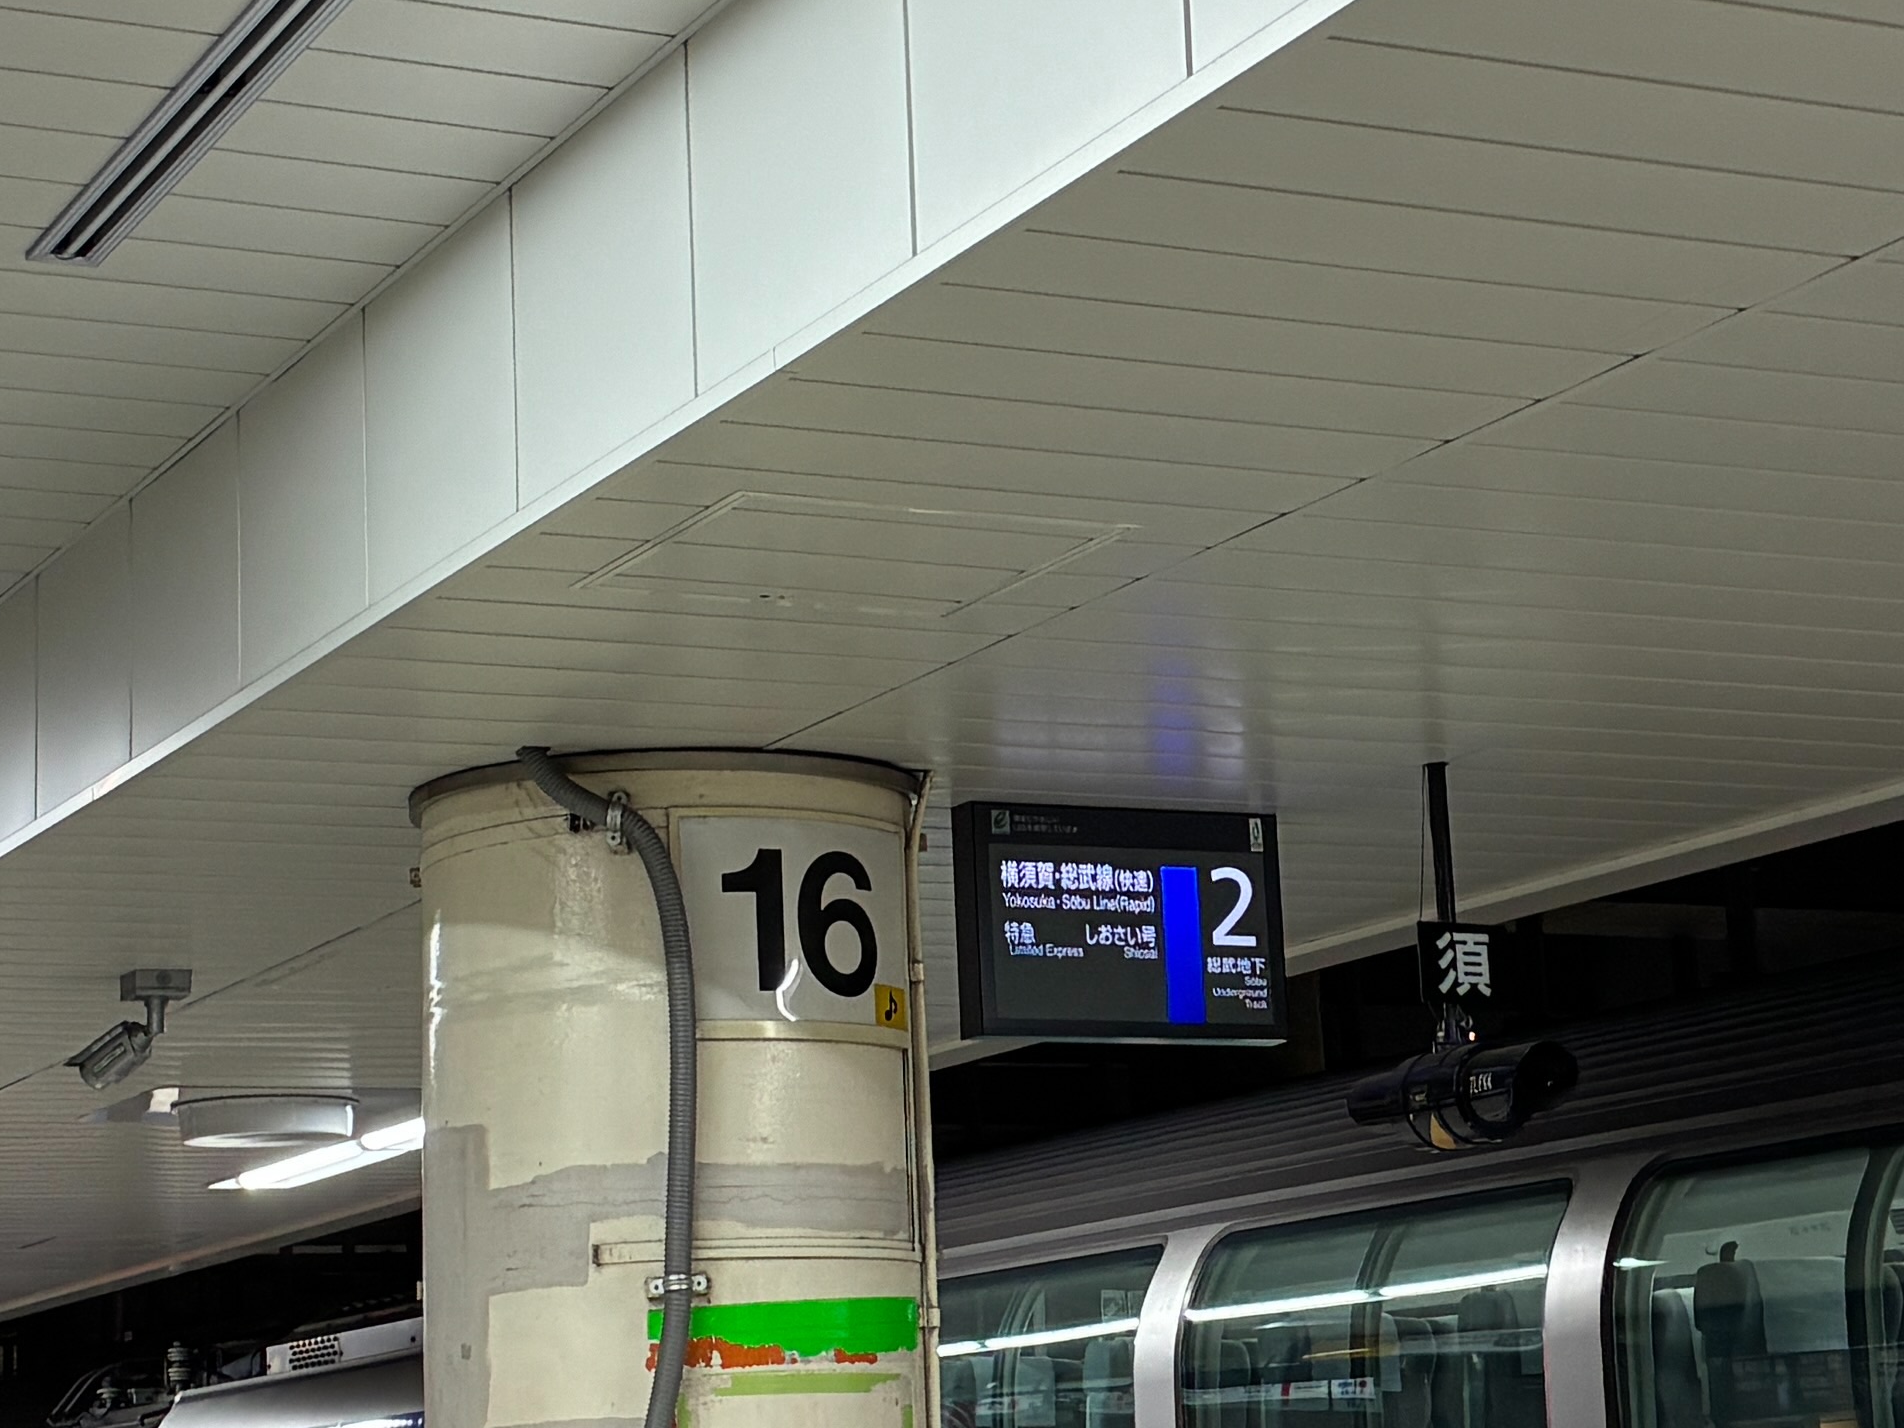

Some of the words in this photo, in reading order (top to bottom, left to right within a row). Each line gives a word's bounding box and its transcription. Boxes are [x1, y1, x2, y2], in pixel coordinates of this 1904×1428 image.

[722, 848, 877, 997] 16
[1211, 867, 1256, 947] 2
[1004, 920, 1036, 945] 特急
[1046, 945, 1084, 958] Express
[1085, 924, 1156, 947] しおさい号
[1436, 931, 1491, 997] 須
